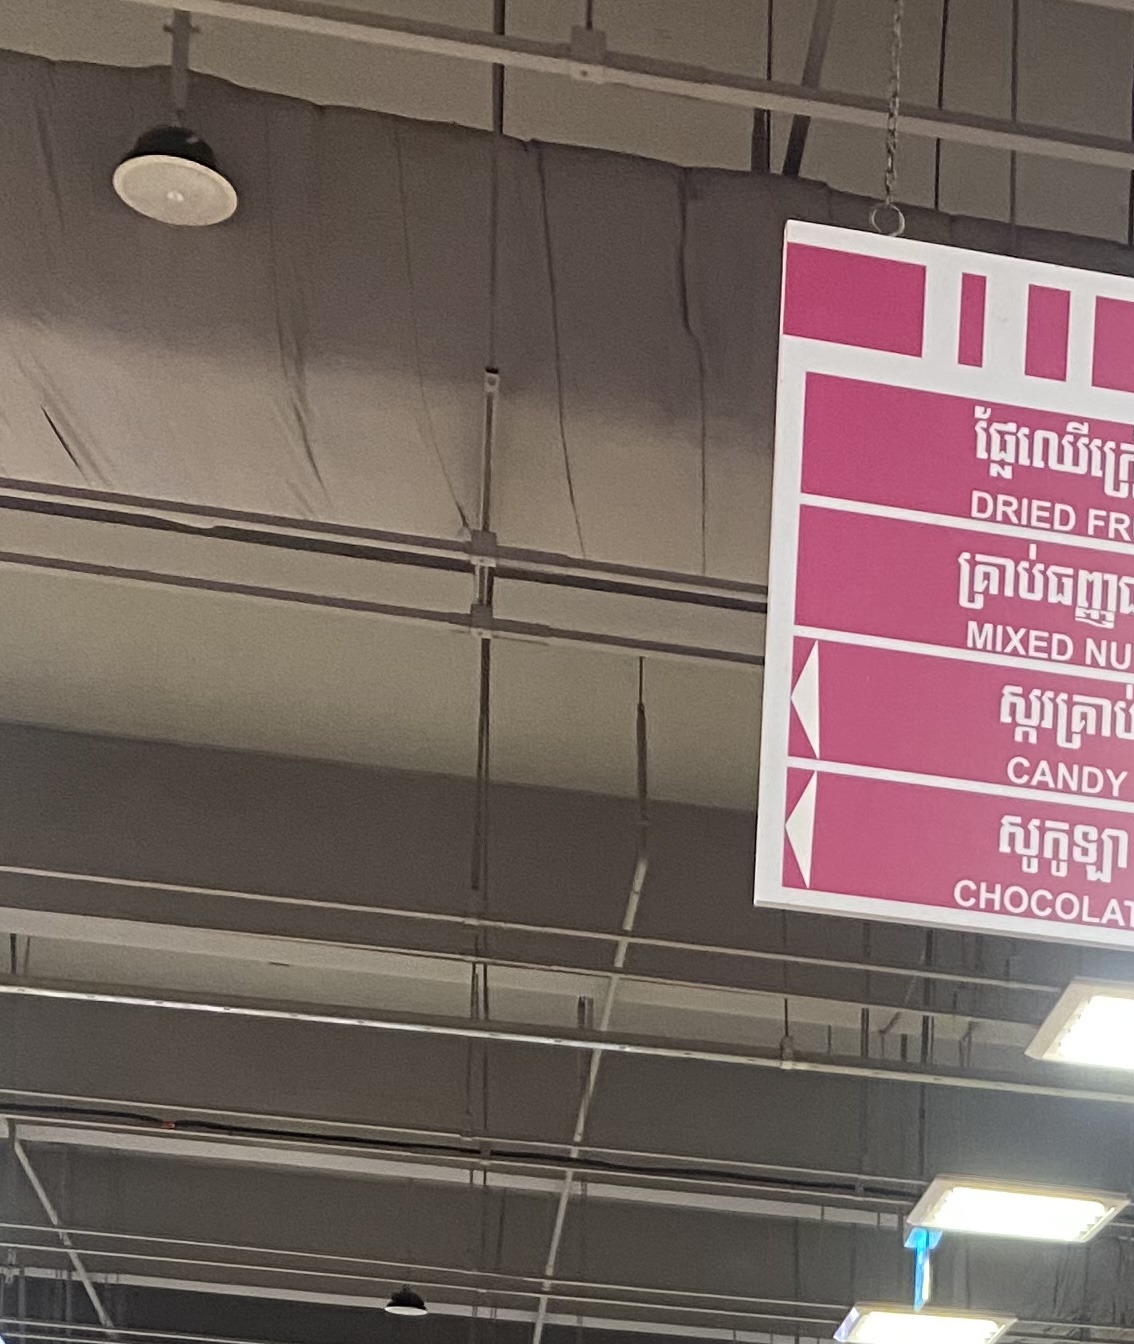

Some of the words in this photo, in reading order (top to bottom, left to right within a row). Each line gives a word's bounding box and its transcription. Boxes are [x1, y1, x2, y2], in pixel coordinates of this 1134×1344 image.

[970, 488, 1077, 533] DRIED
[966, 619, 1075, 663] MIXED
[1007, 756, 1129, 798] CANDY
